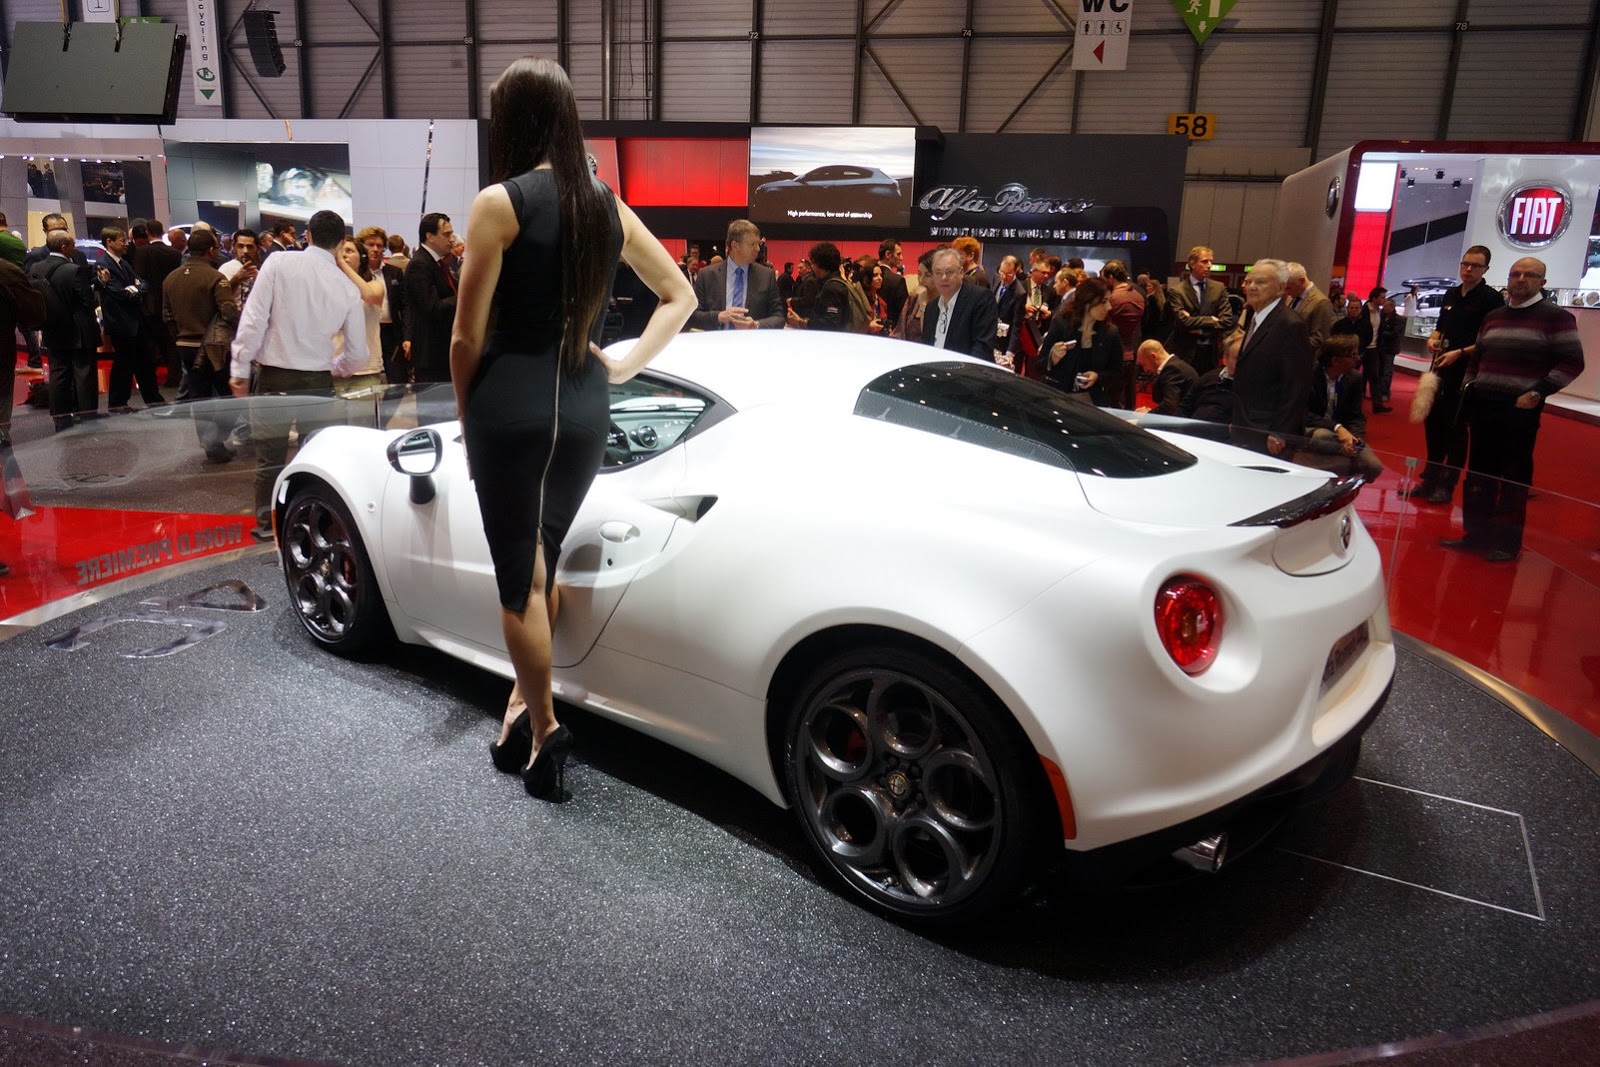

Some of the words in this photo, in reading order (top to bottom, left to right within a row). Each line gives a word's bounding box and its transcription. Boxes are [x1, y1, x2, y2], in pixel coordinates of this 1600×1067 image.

[1082, 0, 1130, 13] WC
[198, 0, 209, 61] cycling
[1456, 22, 1468, 31] 78
[1175, 116, 1208, 138] 58
[919, 186, 990, 221] Alfa
[990, 182, 1094, 214] Romeo
[1510, 197, 1562, 235] FIAT
[930, 226, 969, 237] WITHOUT
[971, 227, 1000, 238] HEART
[1002, 228, 1016, 238] WE
[1018, 229, 1051, 239] WOULD
[1053, 229, 1066, 239] BE
[1068, 230, 1095, 240] MERE
[1096, 231, 1148, 241] MACHINES
